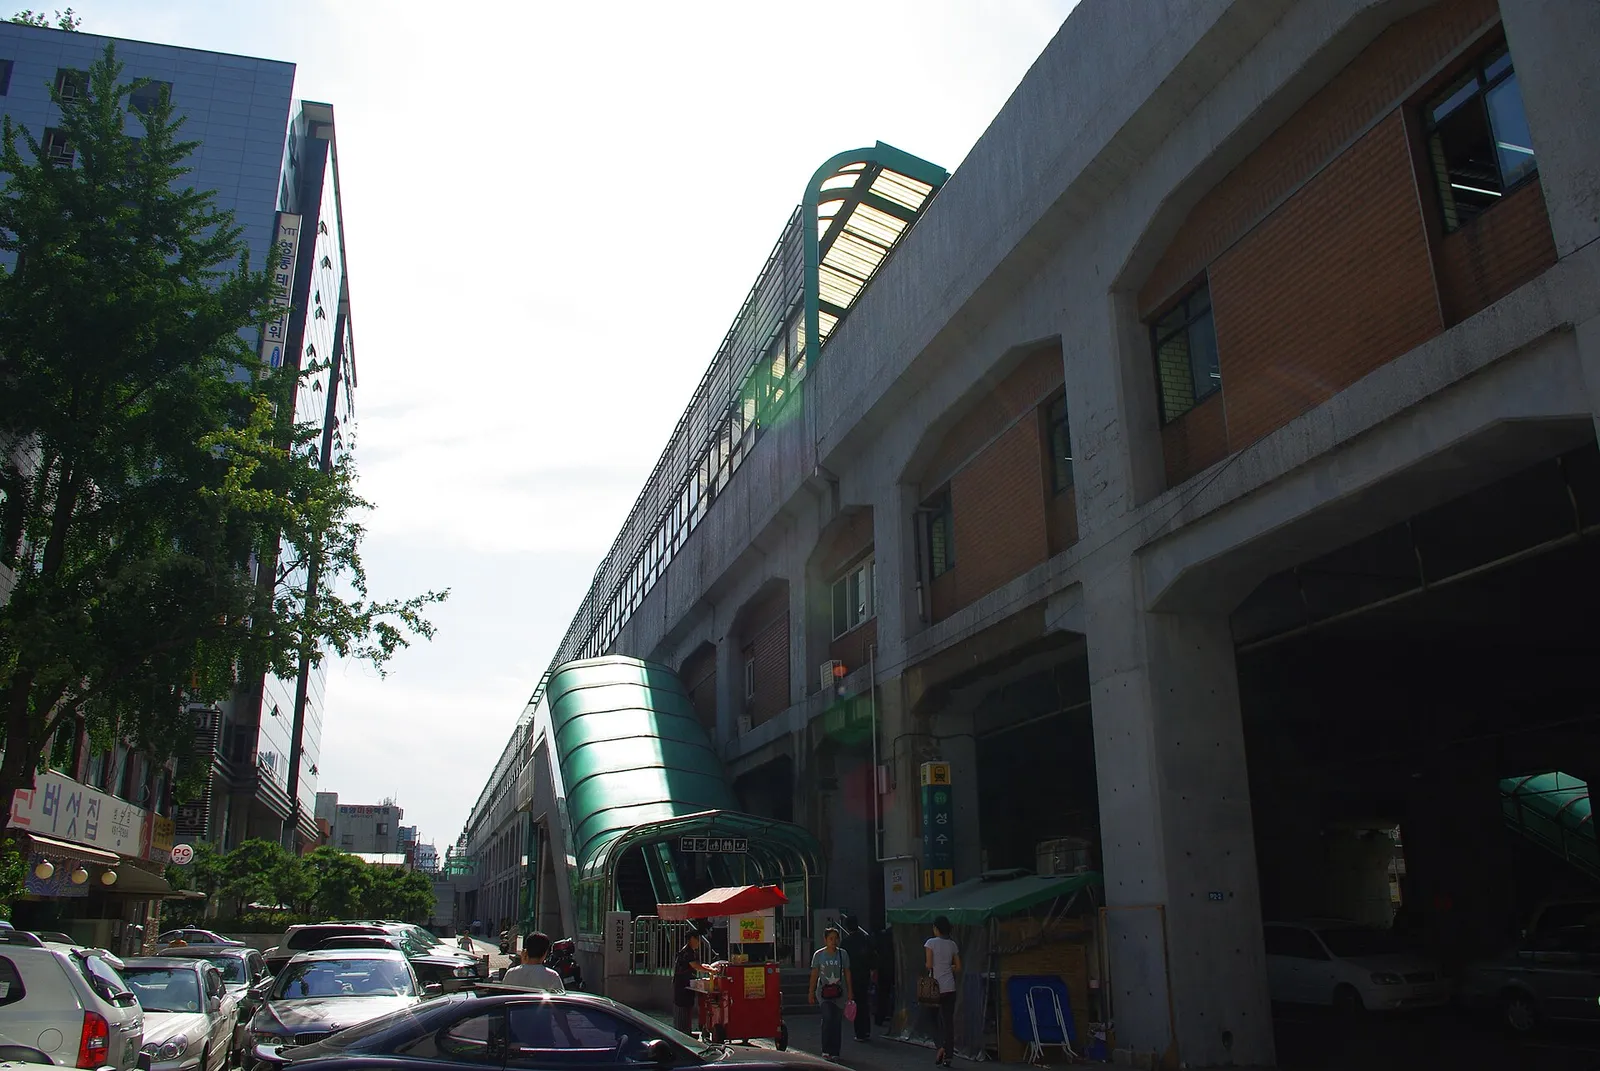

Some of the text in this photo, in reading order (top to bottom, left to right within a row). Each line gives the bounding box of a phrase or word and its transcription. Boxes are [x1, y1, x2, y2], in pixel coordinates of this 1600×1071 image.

[935, 812, 949, 846] 성수
[173, 848, 191, 857] PC
[938, 870, 946, 887] 1
